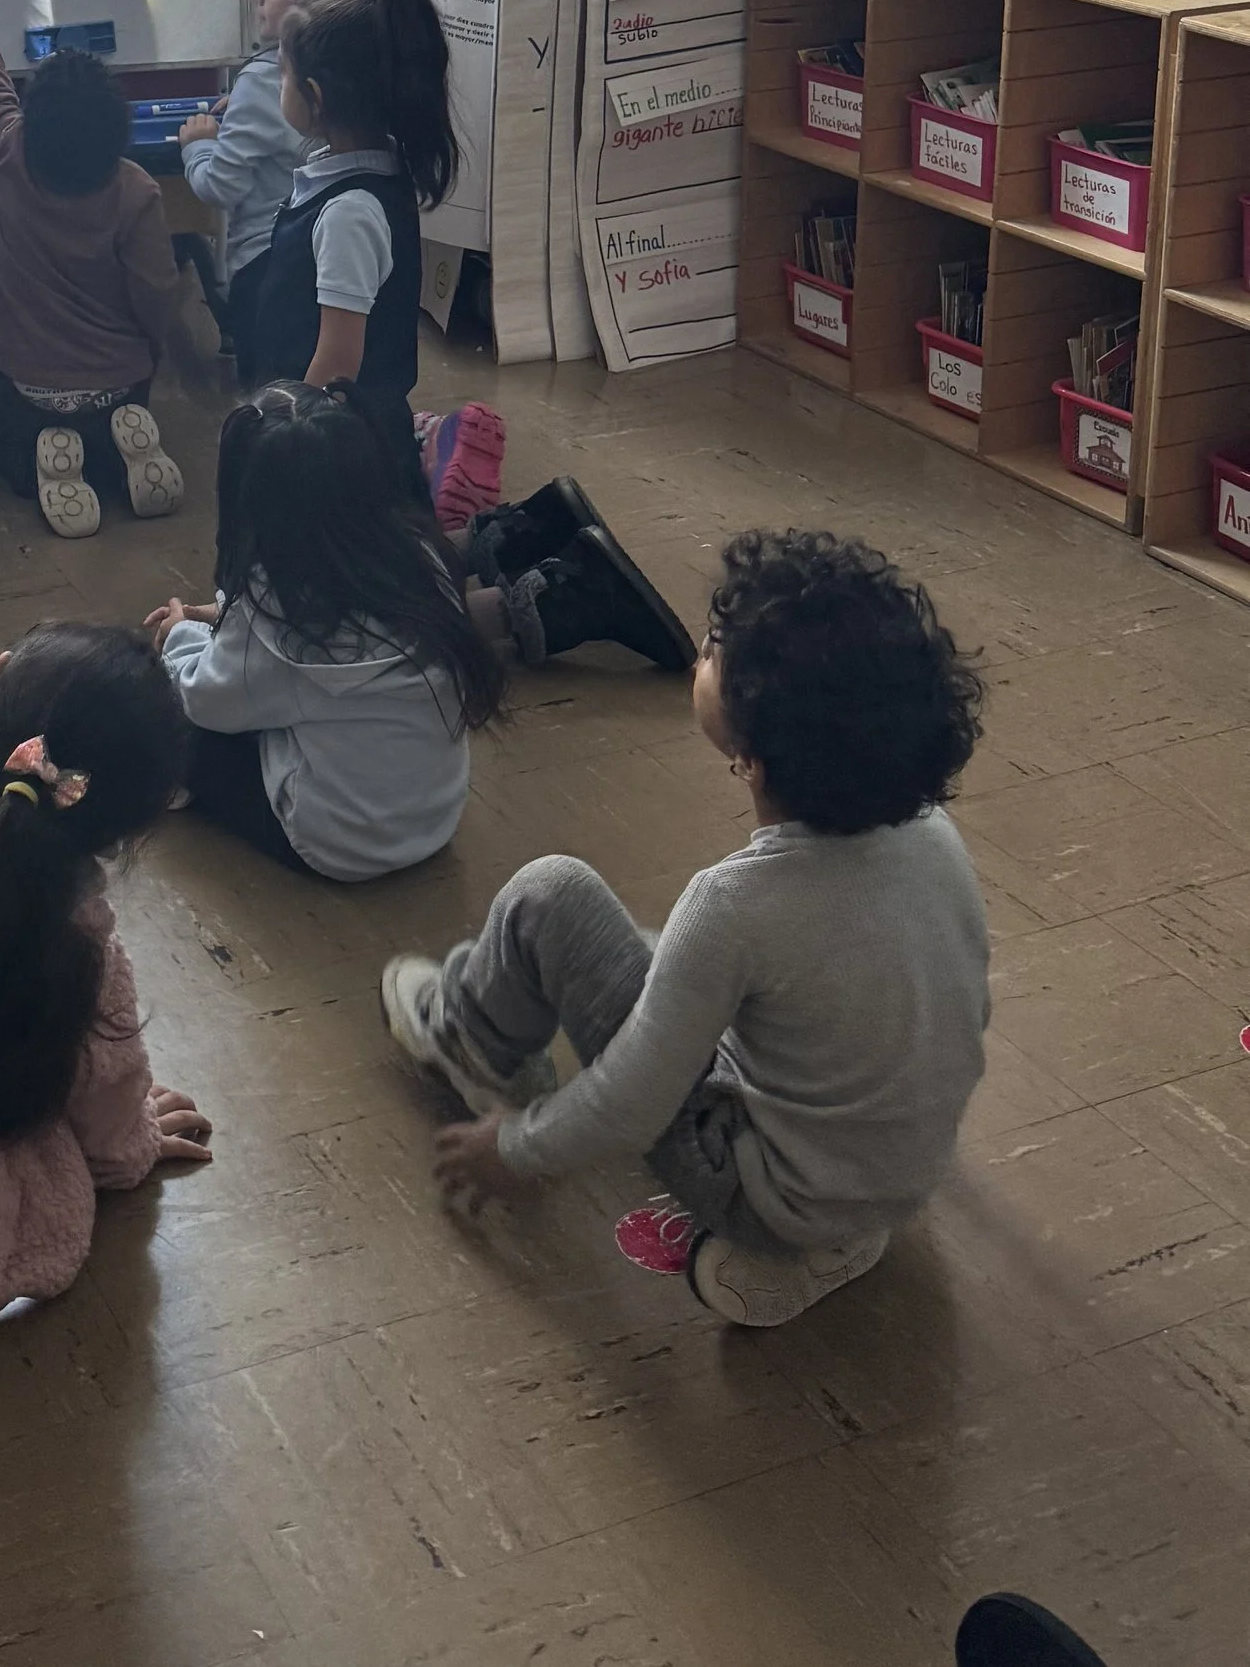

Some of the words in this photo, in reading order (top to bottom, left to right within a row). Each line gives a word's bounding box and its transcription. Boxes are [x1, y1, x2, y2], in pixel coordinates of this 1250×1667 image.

[618, 92, 643, 118] En
[646, 89, 659, 110] el
[665, 81, 712, 107] medio
[611, 120, 684, 150] gigante
[924, 123, 978, 156] Lecturas
[924, 146, 967, 174] fáciles
[1064, 164, 1117, 194] Lecturas
[1064, 193, 1116, 225] transición
[1083, 192, 1095, 204] de
[798, 295, 840, 332] Lugares
